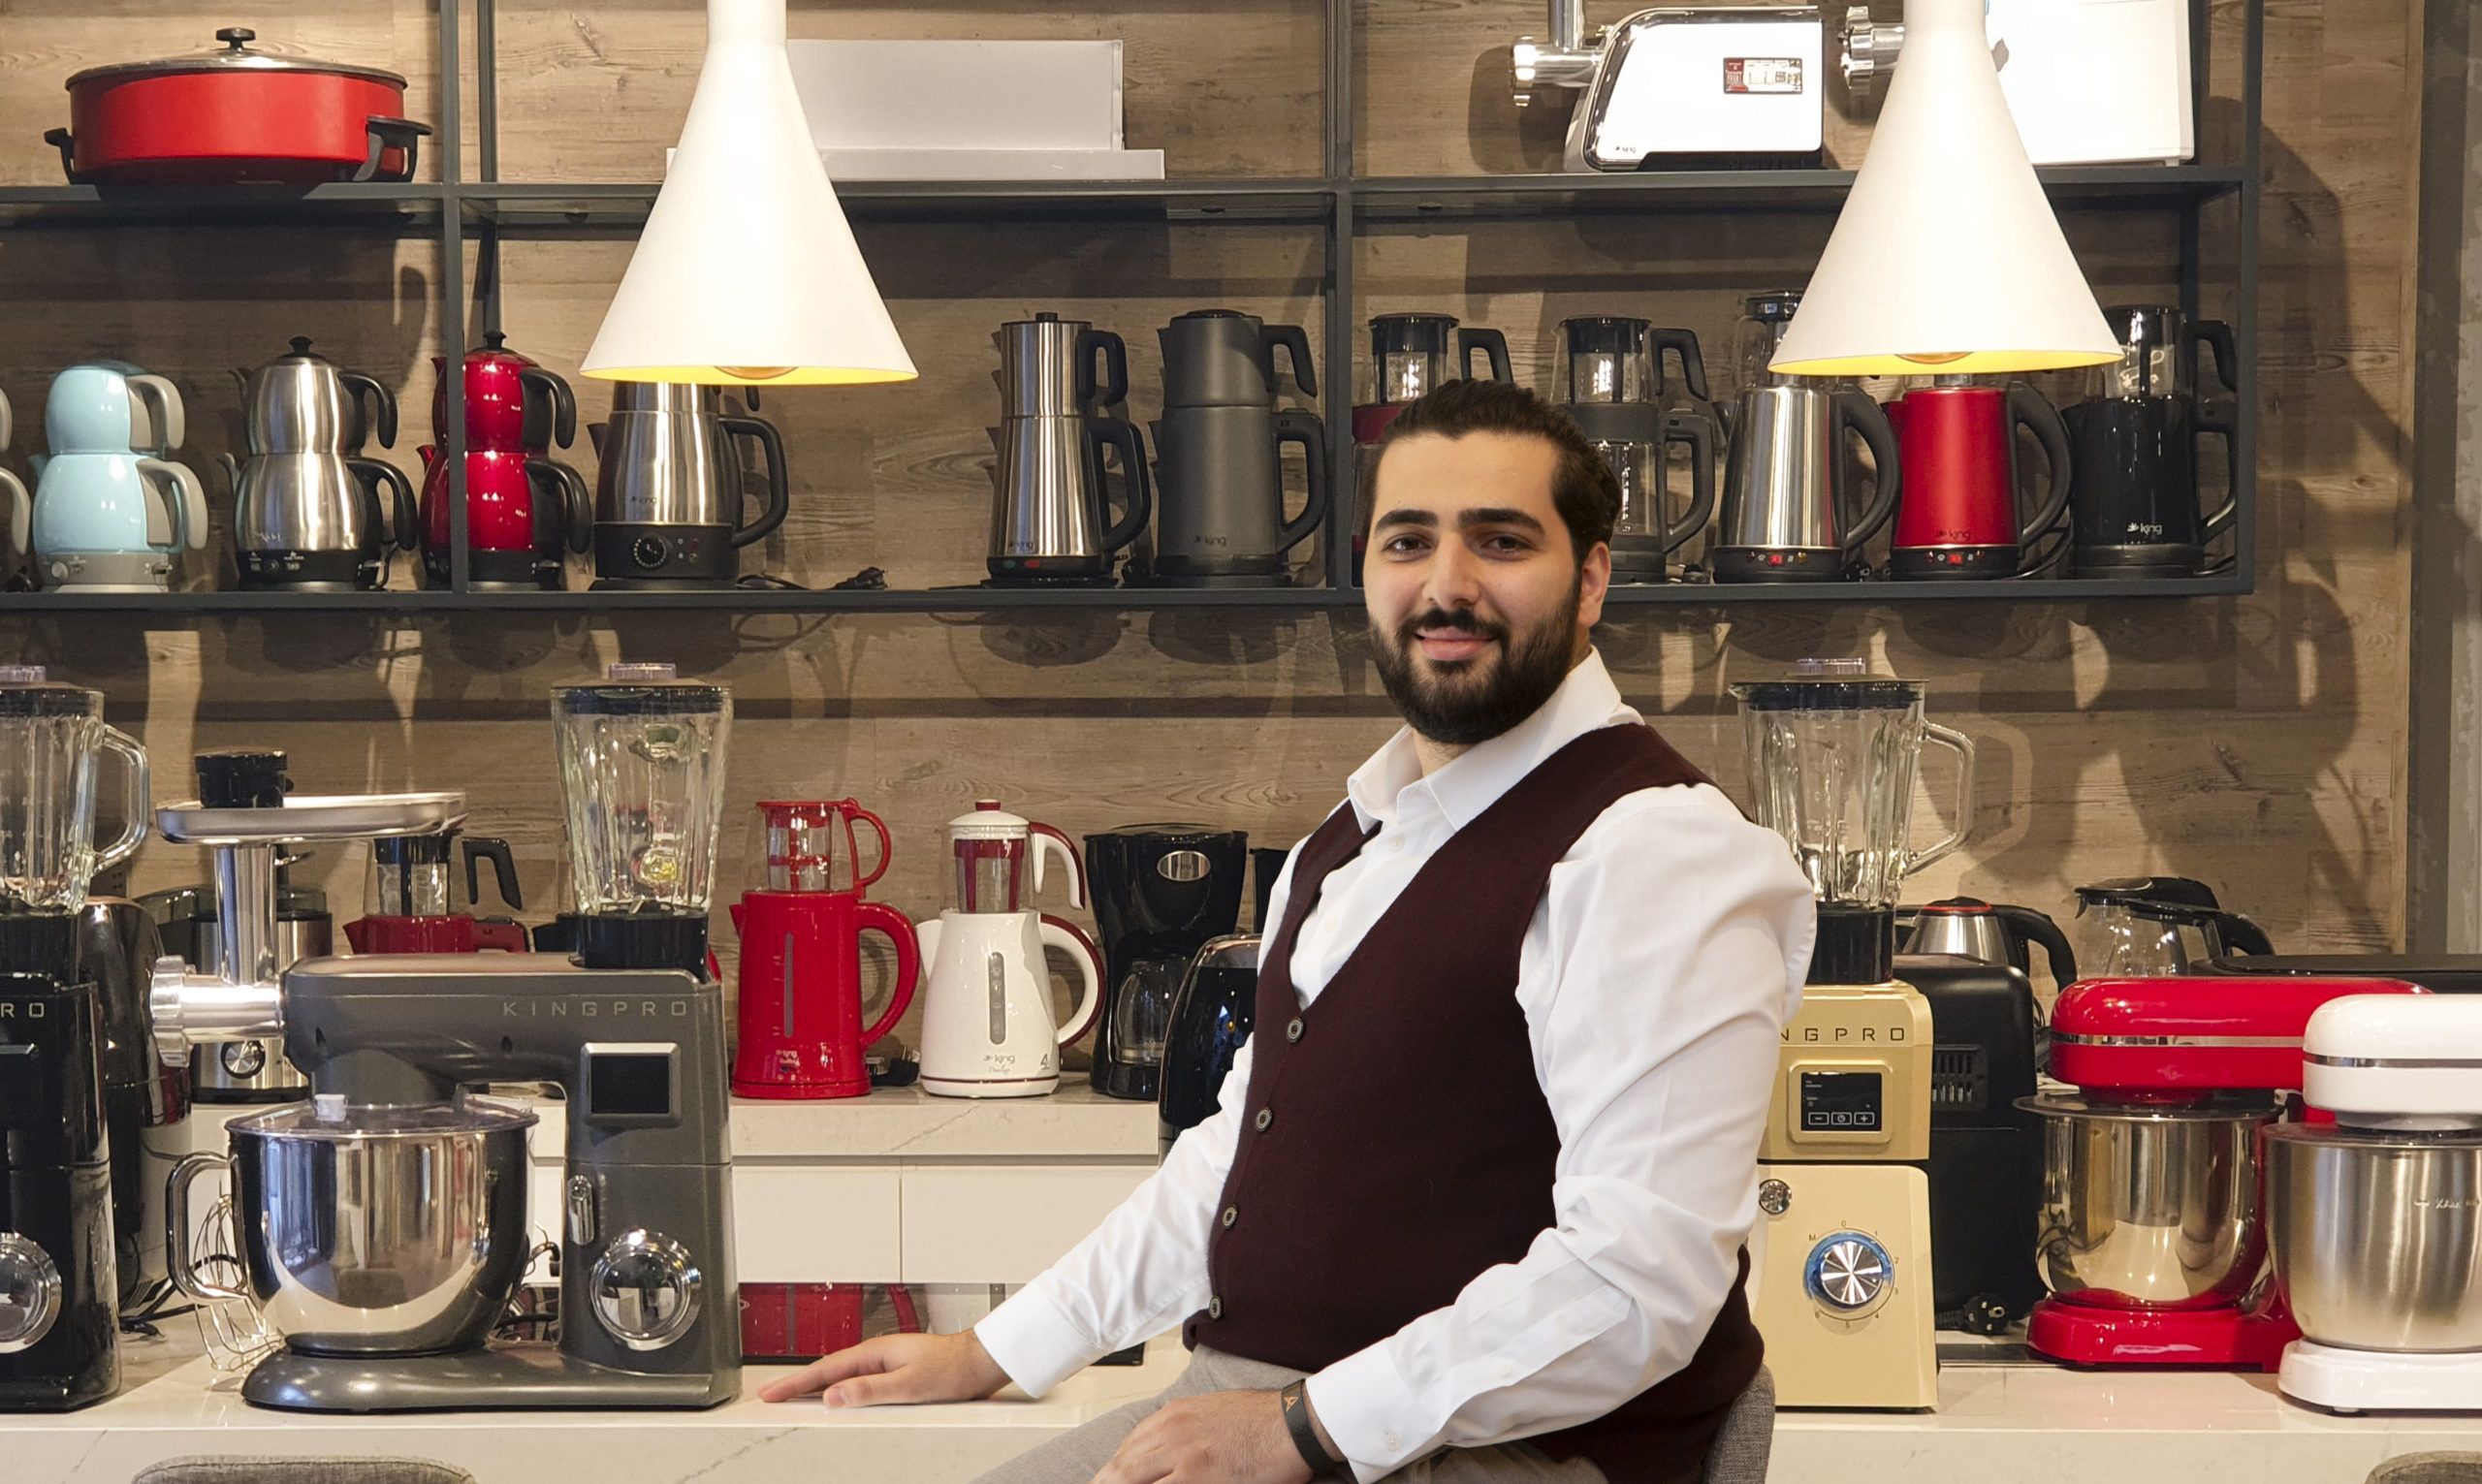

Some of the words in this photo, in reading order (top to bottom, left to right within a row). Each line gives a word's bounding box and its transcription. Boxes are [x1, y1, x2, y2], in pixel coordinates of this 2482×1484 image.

[2140, 522, 2163, 535] king
[0, 1002, 45, 1018] RO
[503, 1001, 687, 1017] KINGPRO
[1780, 1027, 1904, 1042] NGPRO
[995, 1055, 1016, 1064] king
